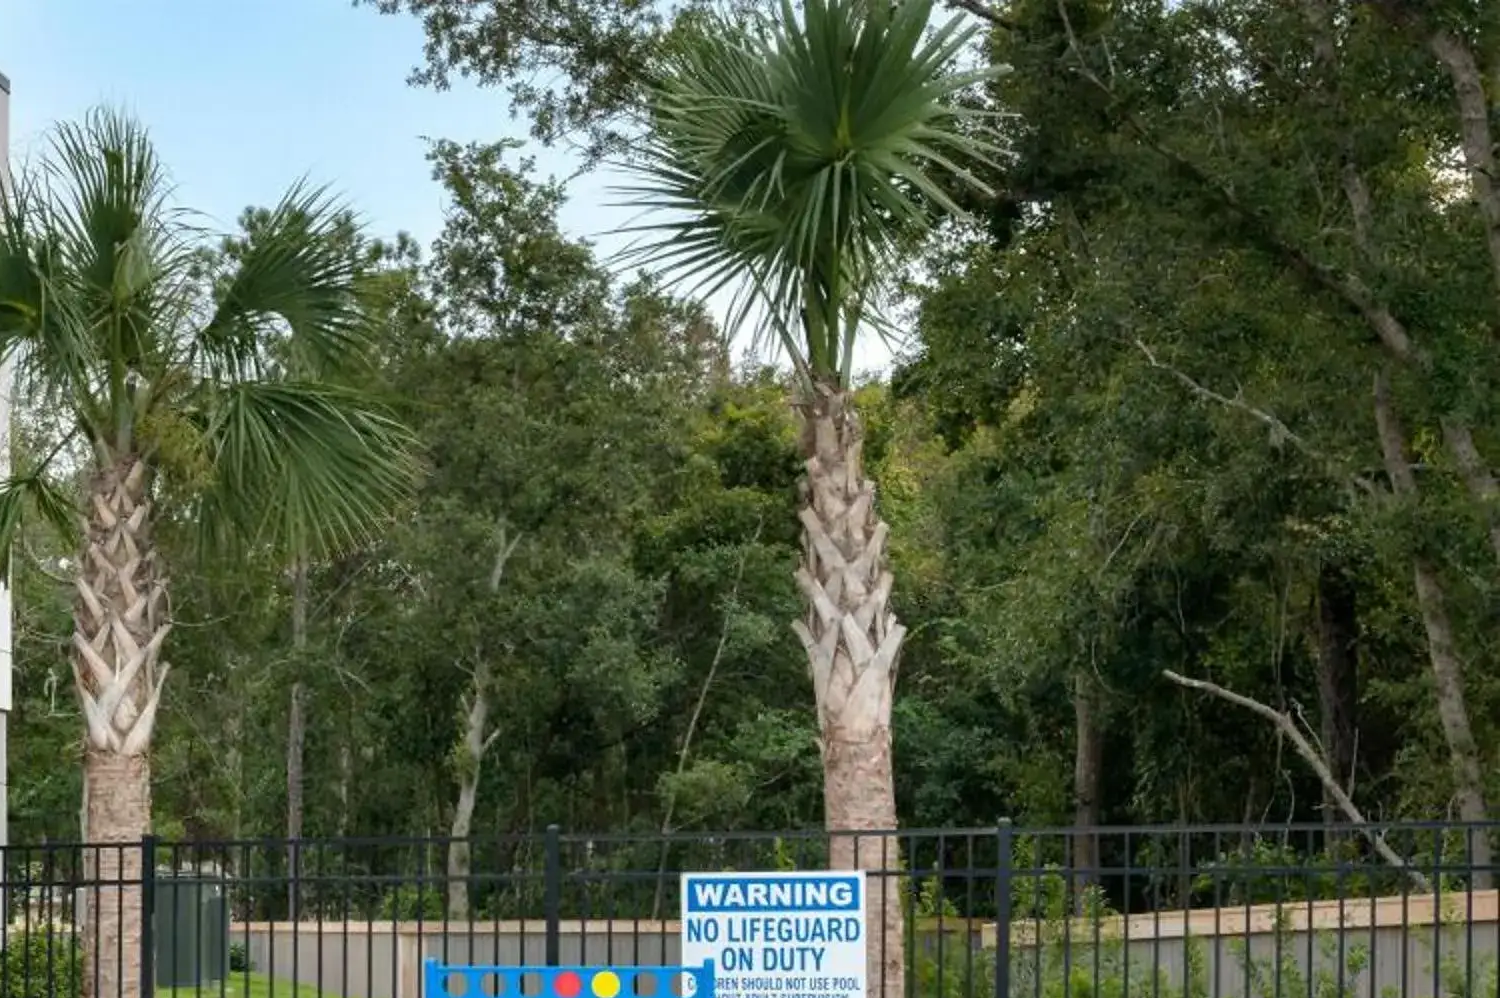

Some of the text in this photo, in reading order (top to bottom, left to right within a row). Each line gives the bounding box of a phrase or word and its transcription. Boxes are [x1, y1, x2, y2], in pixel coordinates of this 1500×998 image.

[694, 883, 853, 907] WARNING
[687, 917, 861, 943] NO LIFEGUARD
[721, 947, 825, 972] ON DUTY
[742, 977, 782, 991] SHOULD
[786, 977, 807, 991] NOT
[809, 977, 830, 991] USE
[832, 977, 861, 991] POOL
